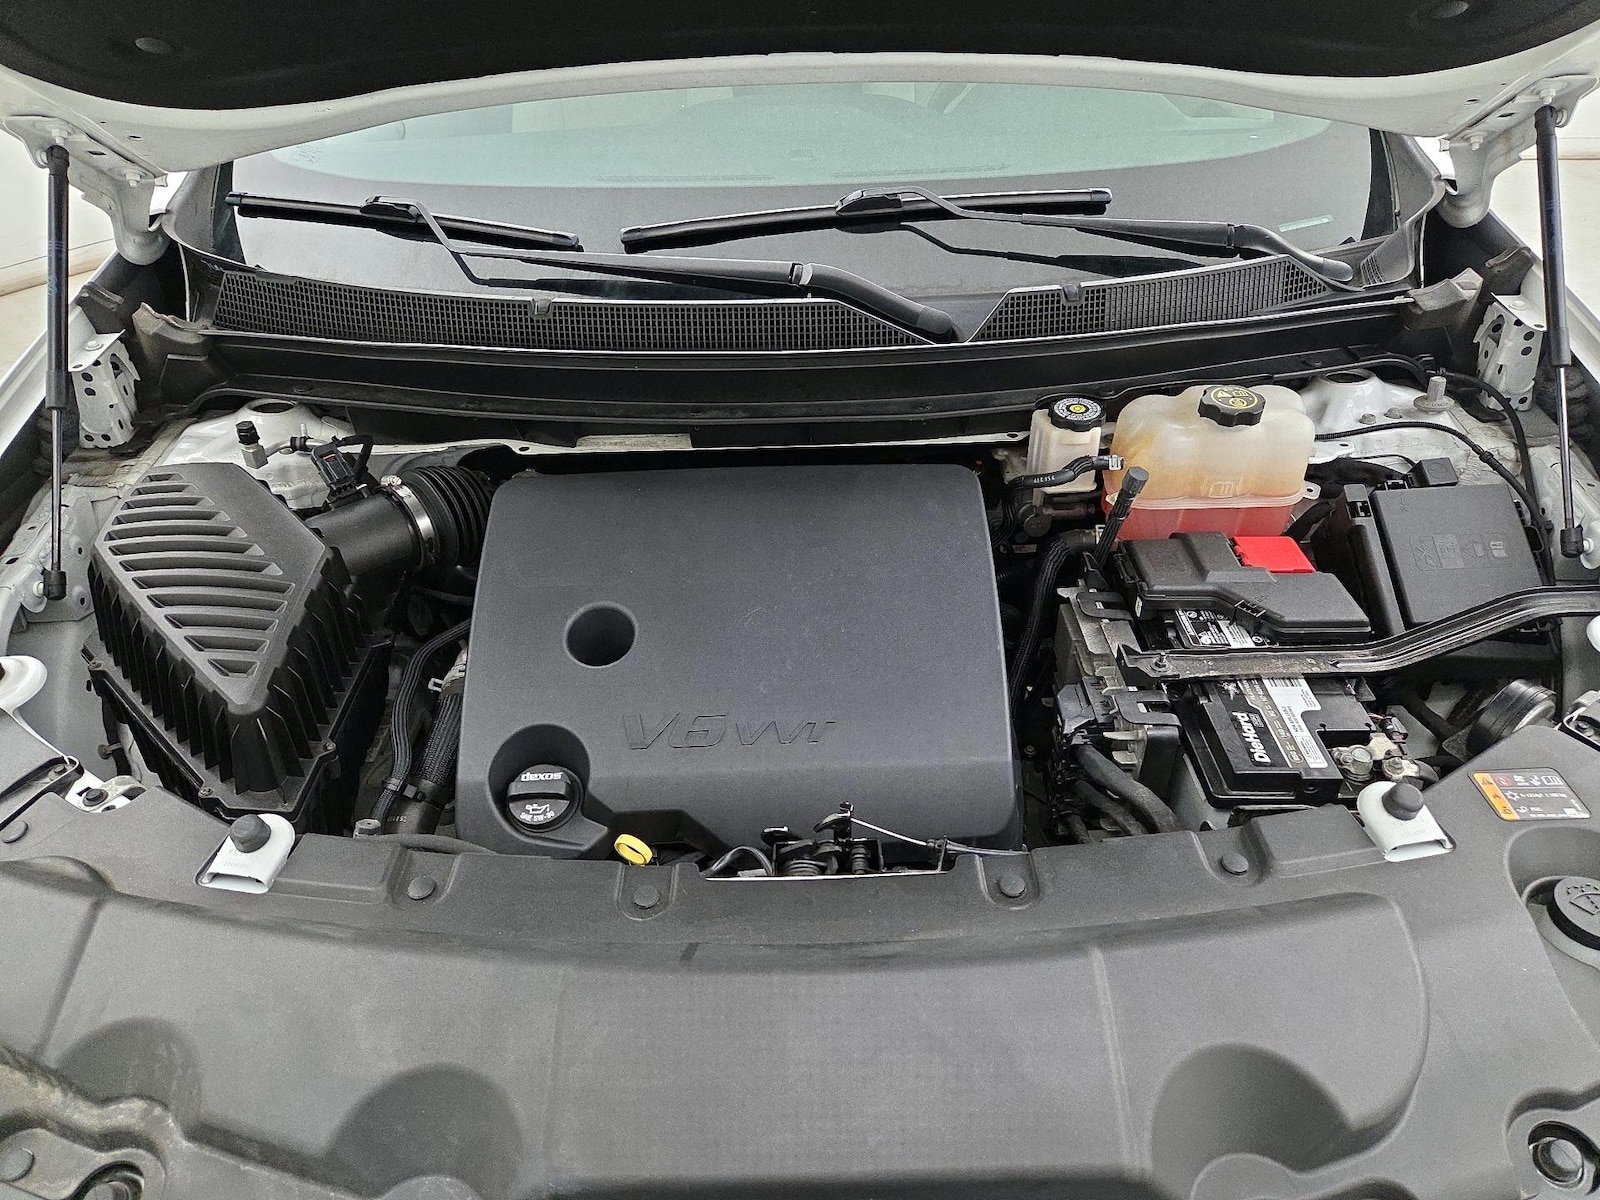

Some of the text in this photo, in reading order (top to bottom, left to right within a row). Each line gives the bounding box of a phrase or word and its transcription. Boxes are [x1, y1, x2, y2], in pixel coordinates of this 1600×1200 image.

[621, 711, 730, 751] V6
[1231, 711, 1271, 763] DieHard
[520, 771, 564, 782] dexos
[519, 810, 555, 822] SAE 5W-30
